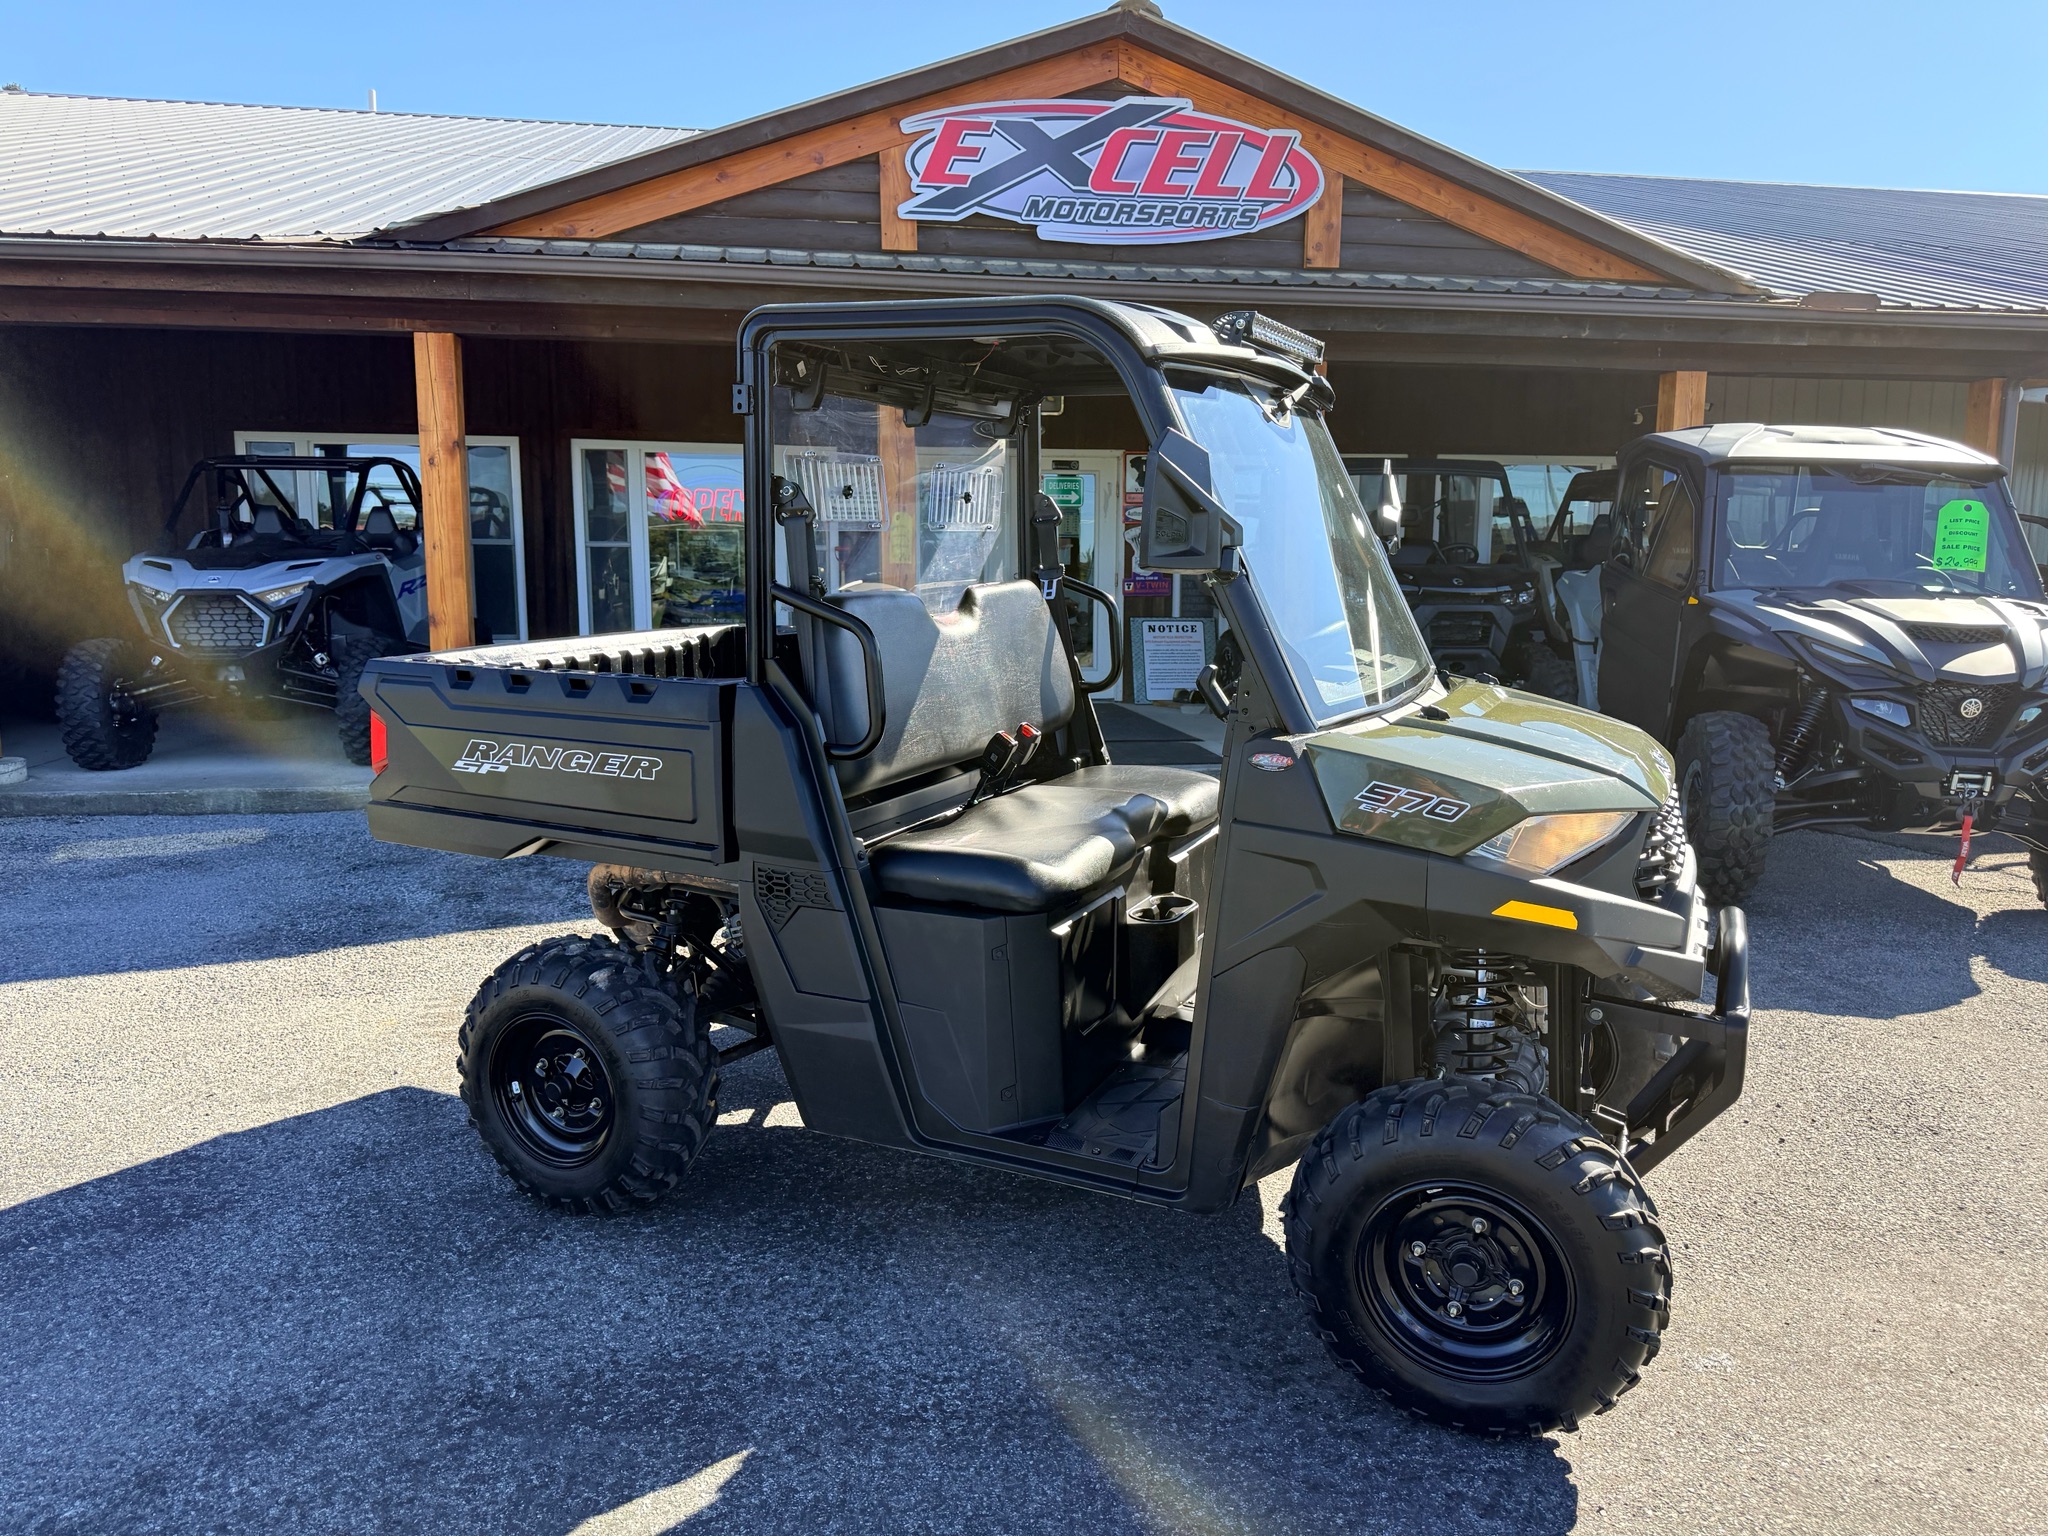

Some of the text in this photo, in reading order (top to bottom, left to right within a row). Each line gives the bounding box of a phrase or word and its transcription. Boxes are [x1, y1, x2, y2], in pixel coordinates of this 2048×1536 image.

[910, 102, 1297, 210] EXCELL
[1022, 196, 1263, 229] MOTORSPORTS
[1048, 481, 1080, 491] DELIVERIES
[1135, 581, 1169, 589] V-TWIN
[1147, 624, 1198, 633] NOTICE
[451, 760, 509, 774] SP
[461, 739, 664, 781] RANGER
[1353, 780, 1471, 823] 570
[1358, 803, 1400, 819] EFI
